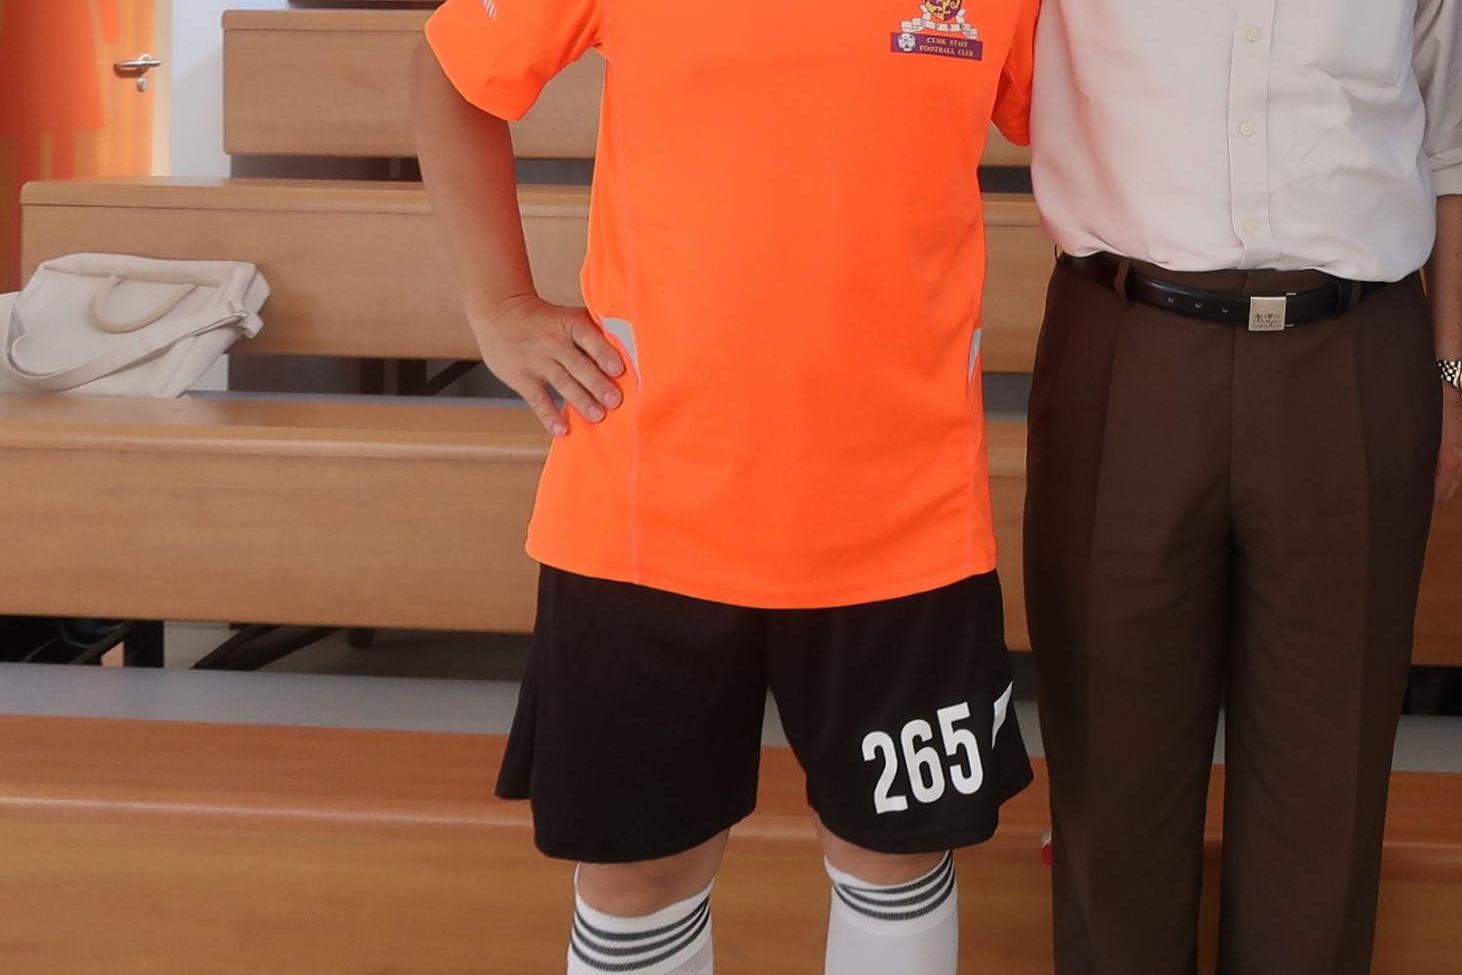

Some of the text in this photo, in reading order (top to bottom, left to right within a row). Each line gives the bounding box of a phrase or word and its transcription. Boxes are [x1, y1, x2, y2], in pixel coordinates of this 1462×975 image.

[919, 45, 974, 57] FOOTBALL CLUB
[861, 701, 984, 815] 265
